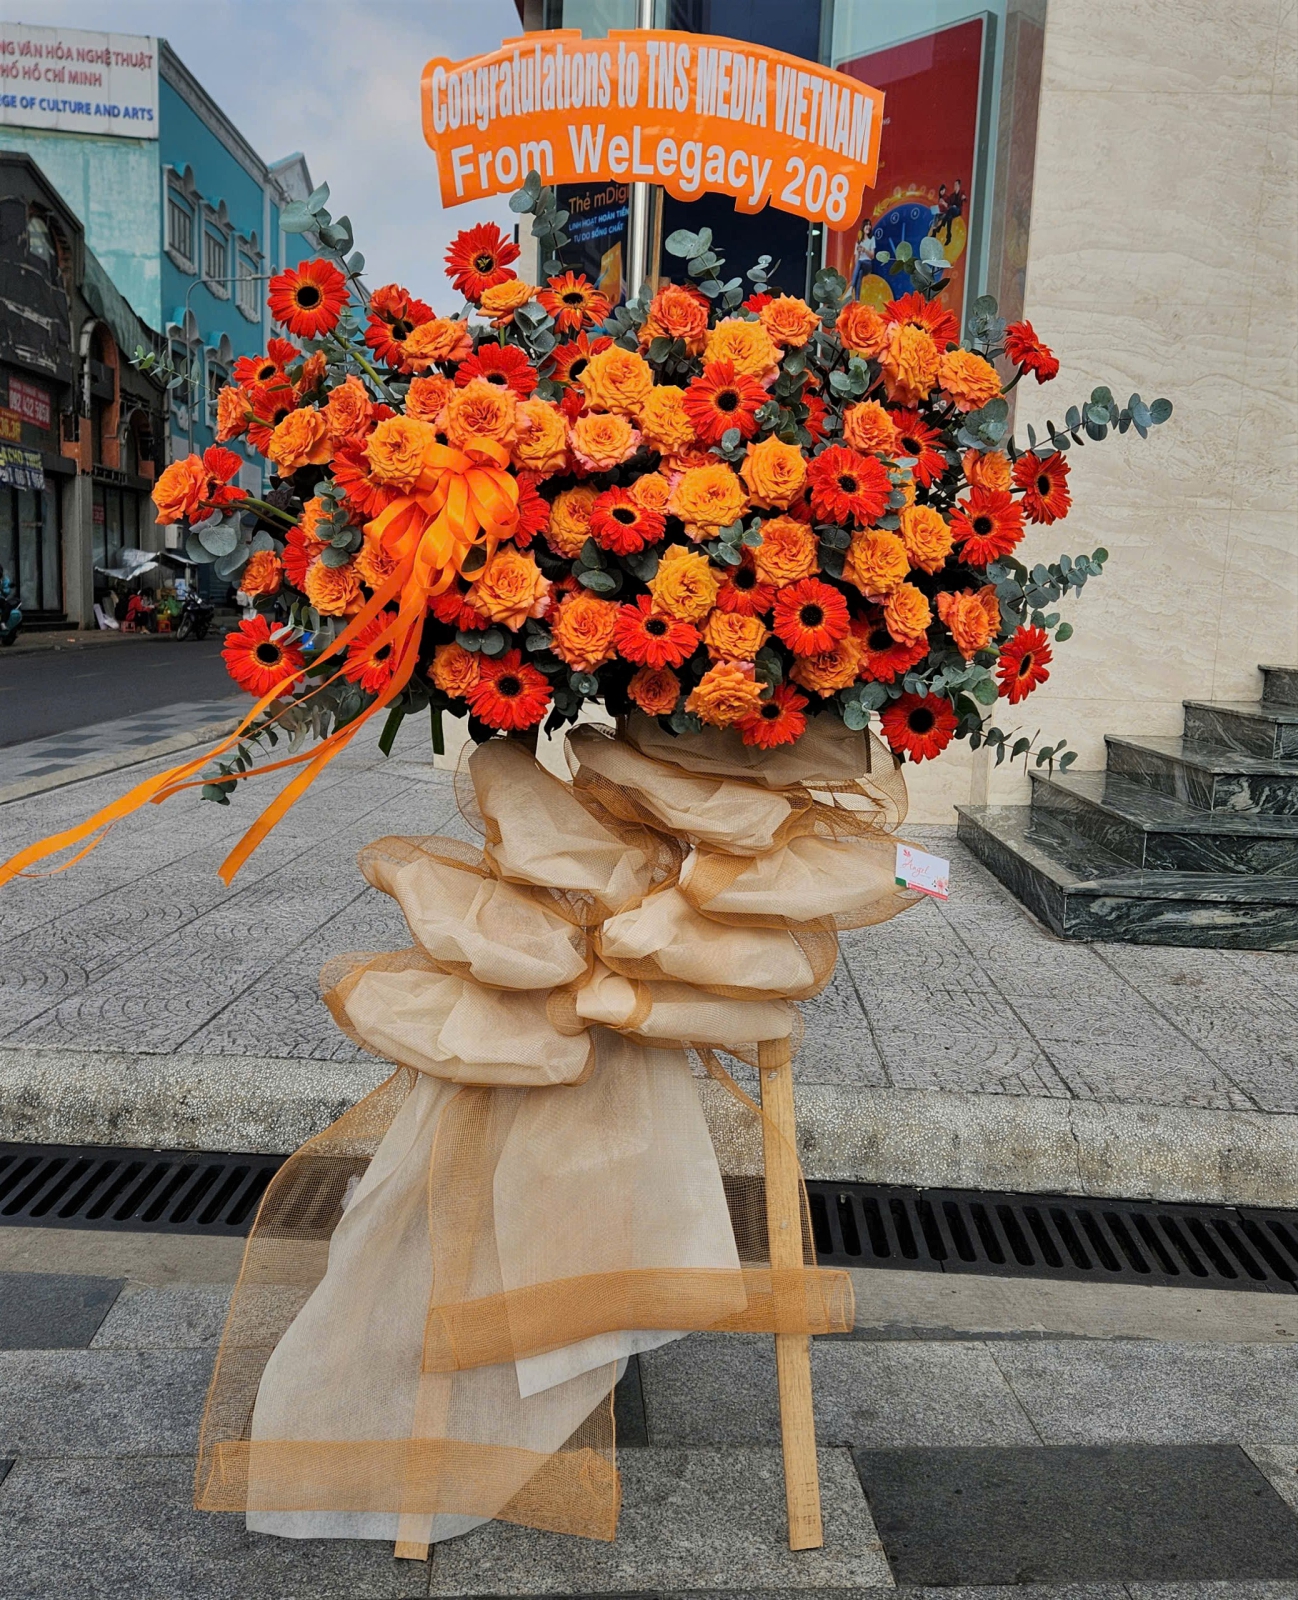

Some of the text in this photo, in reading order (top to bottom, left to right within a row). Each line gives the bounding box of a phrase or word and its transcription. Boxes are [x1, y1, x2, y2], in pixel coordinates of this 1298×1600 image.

[45, 41, 74, 61] HÓA
[76, 47, 111, 67] NGHỆ
[113, 51, 153, 71] THUẬT
[44, 66, 65, 84] CHÍ
[68, 70, 102, 87] MINH
[20, 96, 36, 109] OF
[39, 98, 92, 116] CULTURE
[94, 102, 121, 118] AND
[122, 105, 154, 121] ARTS
[431, 40, 874, 166] Congratulations to TNS MEDIA VIETNAM
[451, 124, 850, 222] From WeLegacy 208
